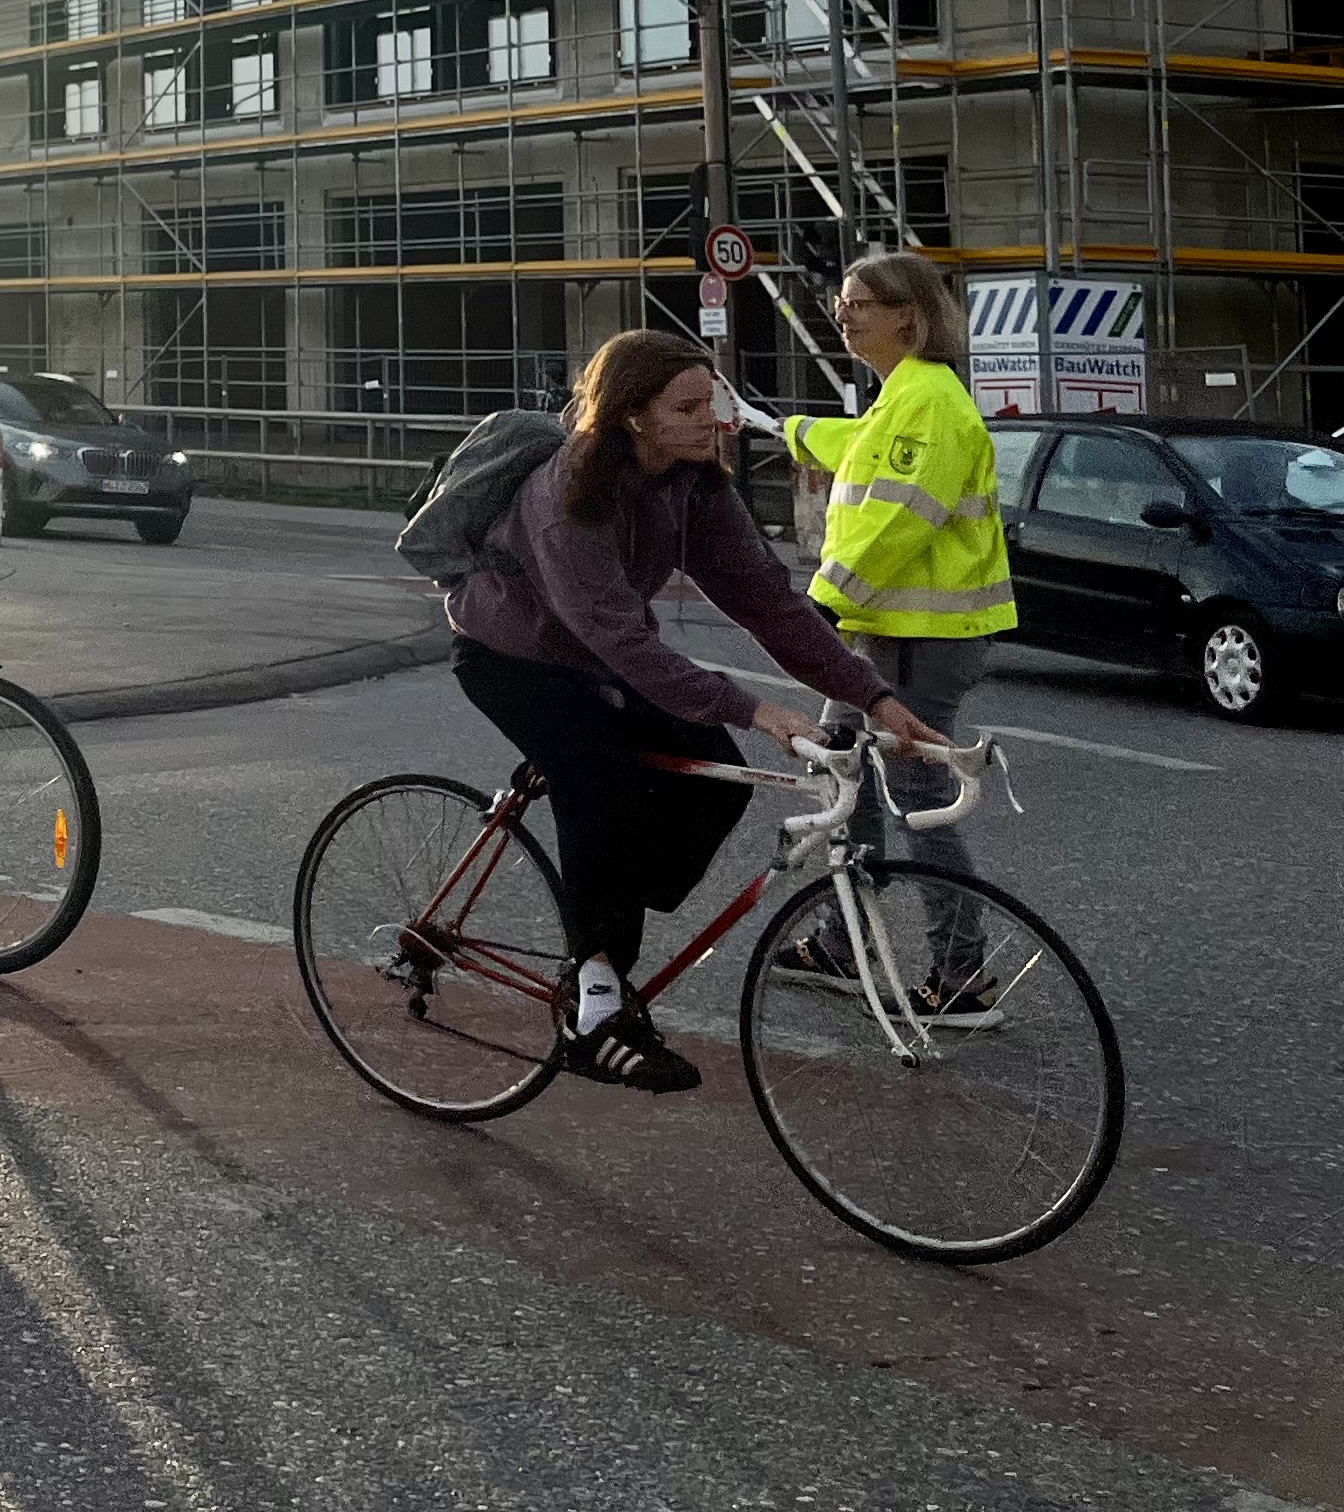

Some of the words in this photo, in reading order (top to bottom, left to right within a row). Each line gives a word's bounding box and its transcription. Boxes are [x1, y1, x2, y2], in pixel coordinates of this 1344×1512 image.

[717, 240, 744, 264] 50
[973, 356, 1038, 373] BauWatch
[1055, 357, 1141, 377] BauWatch
